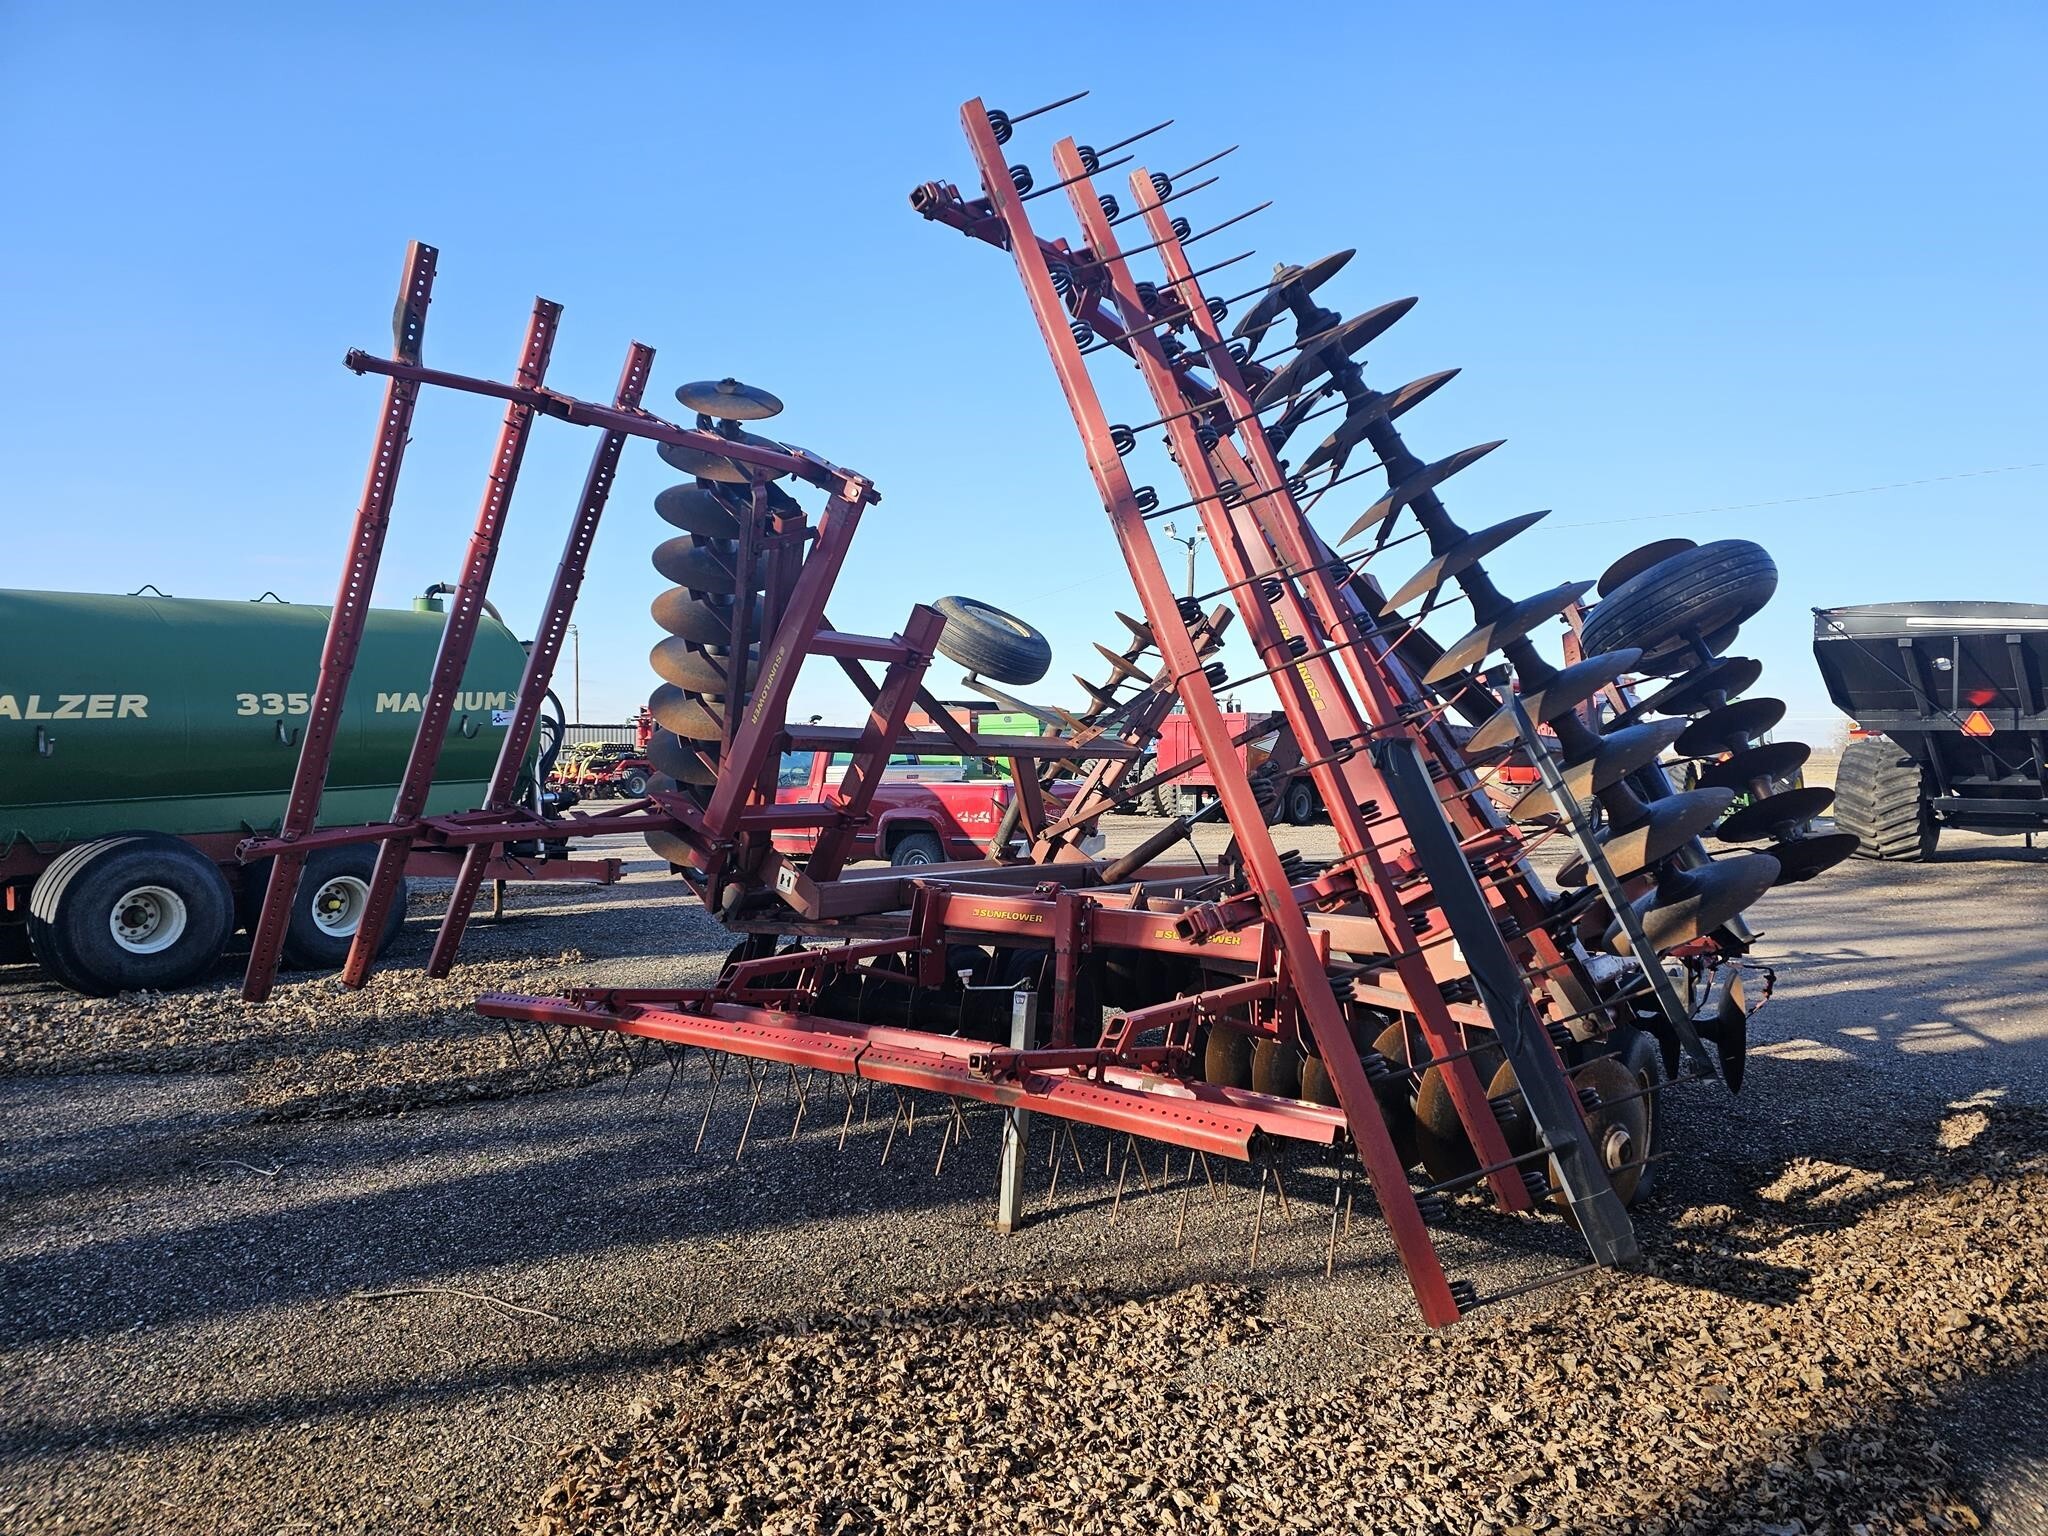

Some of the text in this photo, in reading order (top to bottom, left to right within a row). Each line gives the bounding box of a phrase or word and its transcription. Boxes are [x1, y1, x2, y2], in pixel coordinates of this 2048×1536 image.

[751, 654, 783, 724] SUNFLOWER
[236, 693, 318, 716] 335
[375, 692, 507, 713] MANUM
[980, 909, 1043, 922] SUNFLOWER
